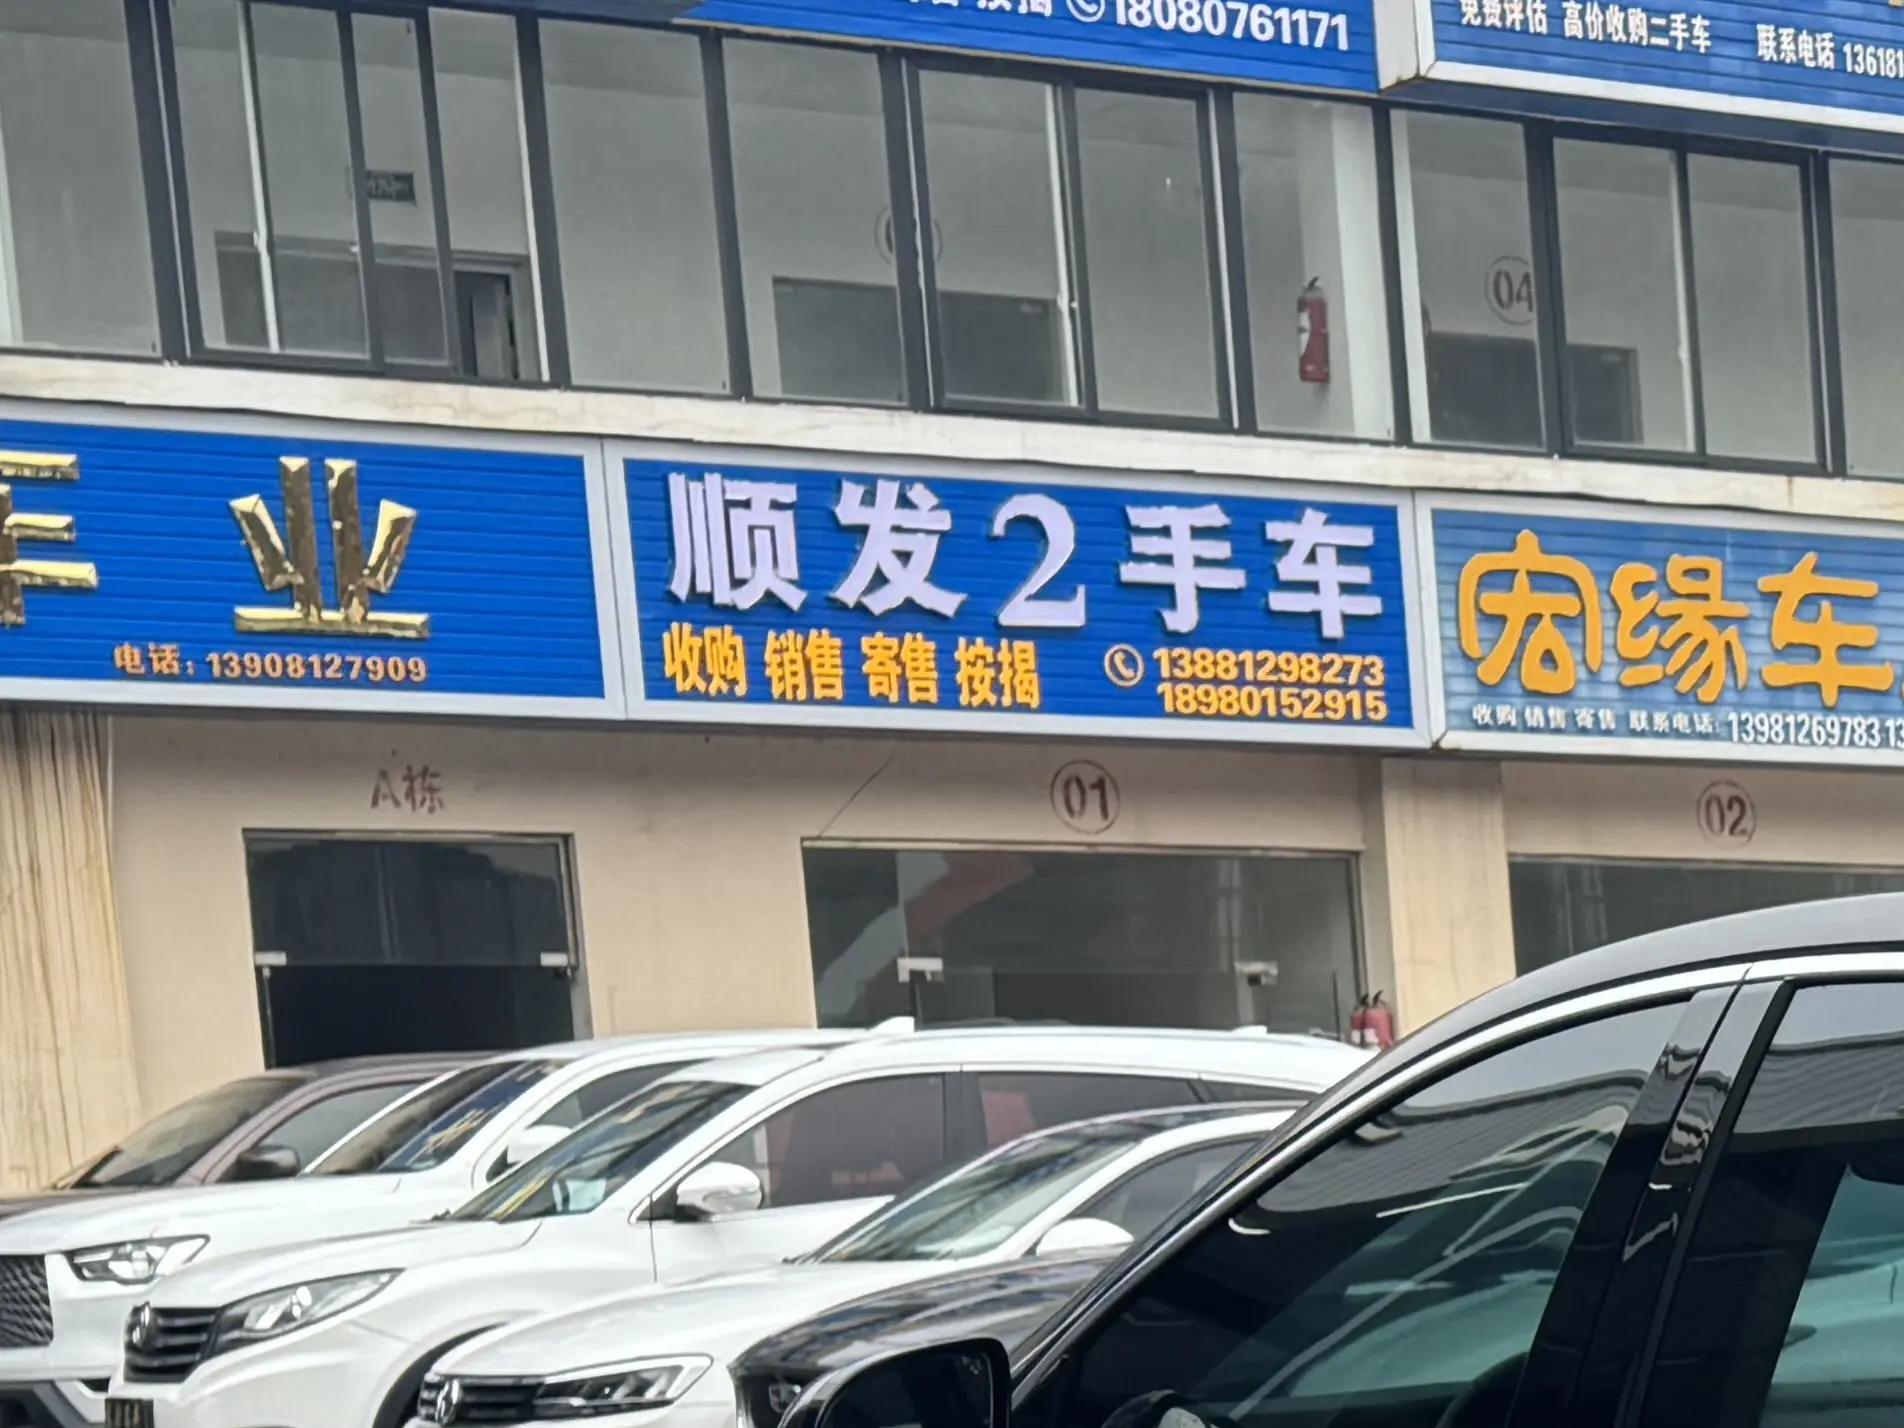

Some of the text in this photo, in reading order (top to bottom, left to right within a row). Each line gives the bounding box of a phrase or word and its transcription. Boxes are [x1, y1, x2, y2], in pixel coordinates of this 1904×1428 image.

[1114, 0, 1349, 51] 18080761171
[1562, 1, 1712, 53] 高价收购二手车
[1756, 24, 1836, 70] 联系电话
[1492, 270, 1533, 313] 04
[665, 472, 1385, 640] 顺发2手车
[206, 651, 428, 683] 13908127909
[662, 622, 1386, 709] 收购 销售 寄售 按揭 13881298273
[1156, 682, 1389, 721] 18980152915
[1727, 711, 1881, 748] 13981269783
[370, 766, 445, 814] A栋
[1062, 774, 1112, 823] 01
[1704, 795, 1748, 838] 02
